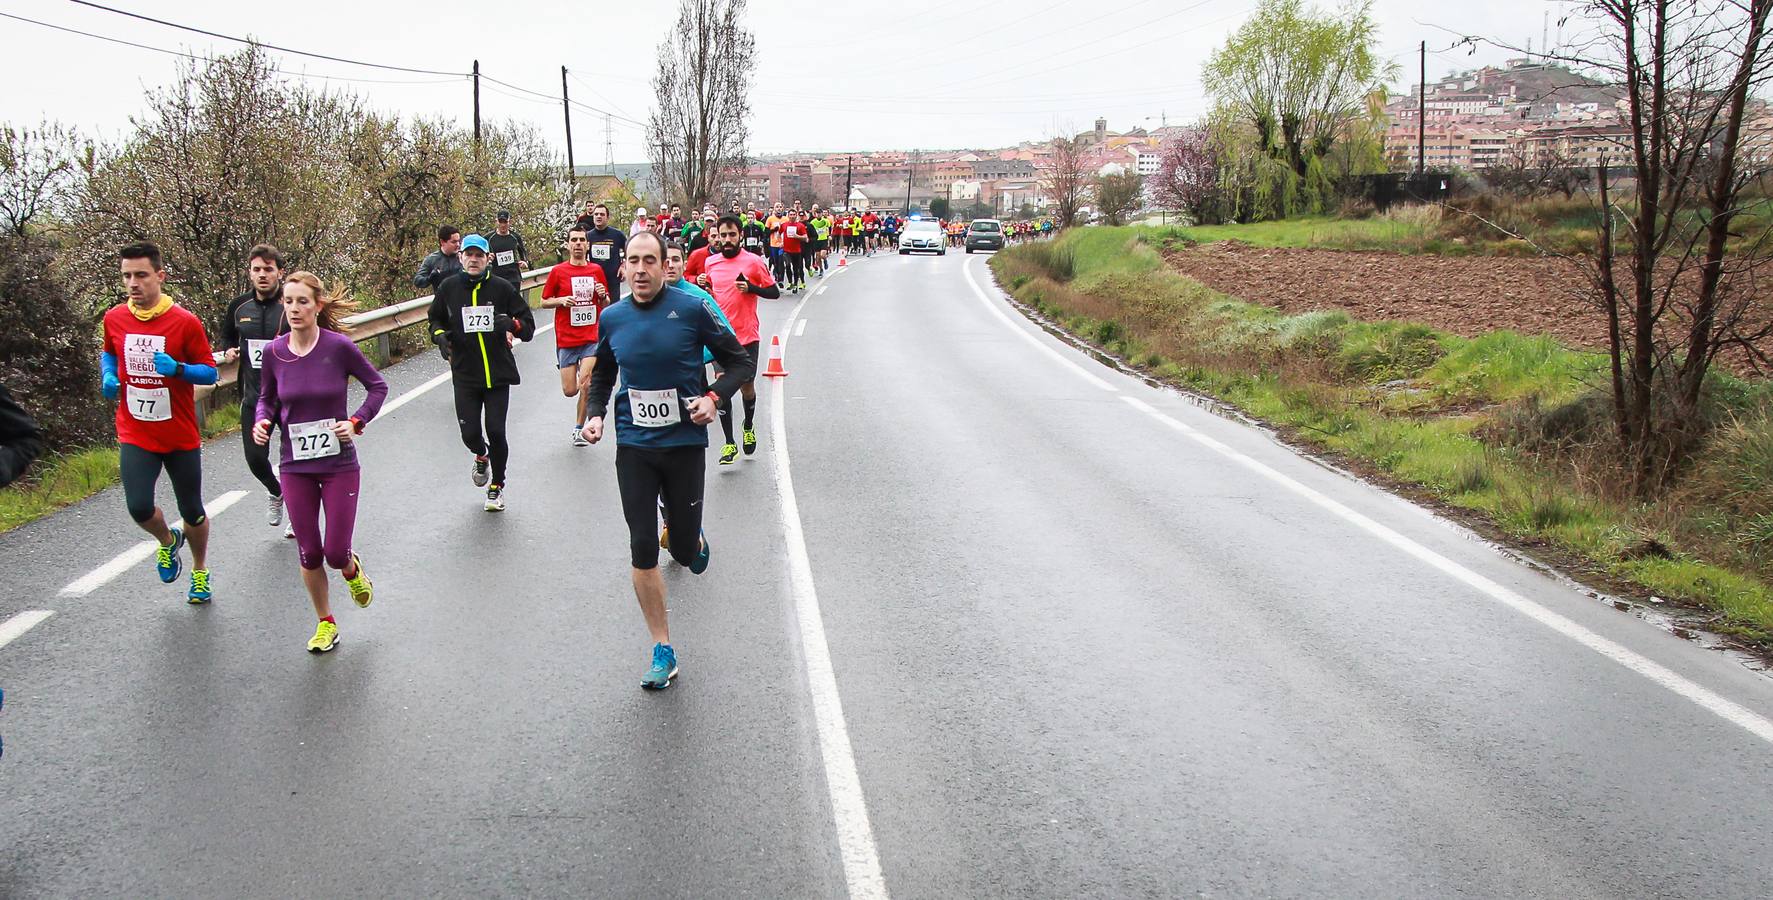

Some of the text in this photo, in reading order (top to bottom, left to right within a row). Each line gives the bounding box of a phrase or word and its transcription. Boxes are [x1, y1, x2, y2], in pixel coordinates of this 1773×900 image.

[468, 315, 490, 326] 273
[575, 312, 592, 322] 306
[254, 349, 263, 362] 2
[129, 363, 157, 372] IREGU
[137, 399, 156, 414] 77
[638, 402, 670, 419] 300
[298, 433, 331, 451] 272
